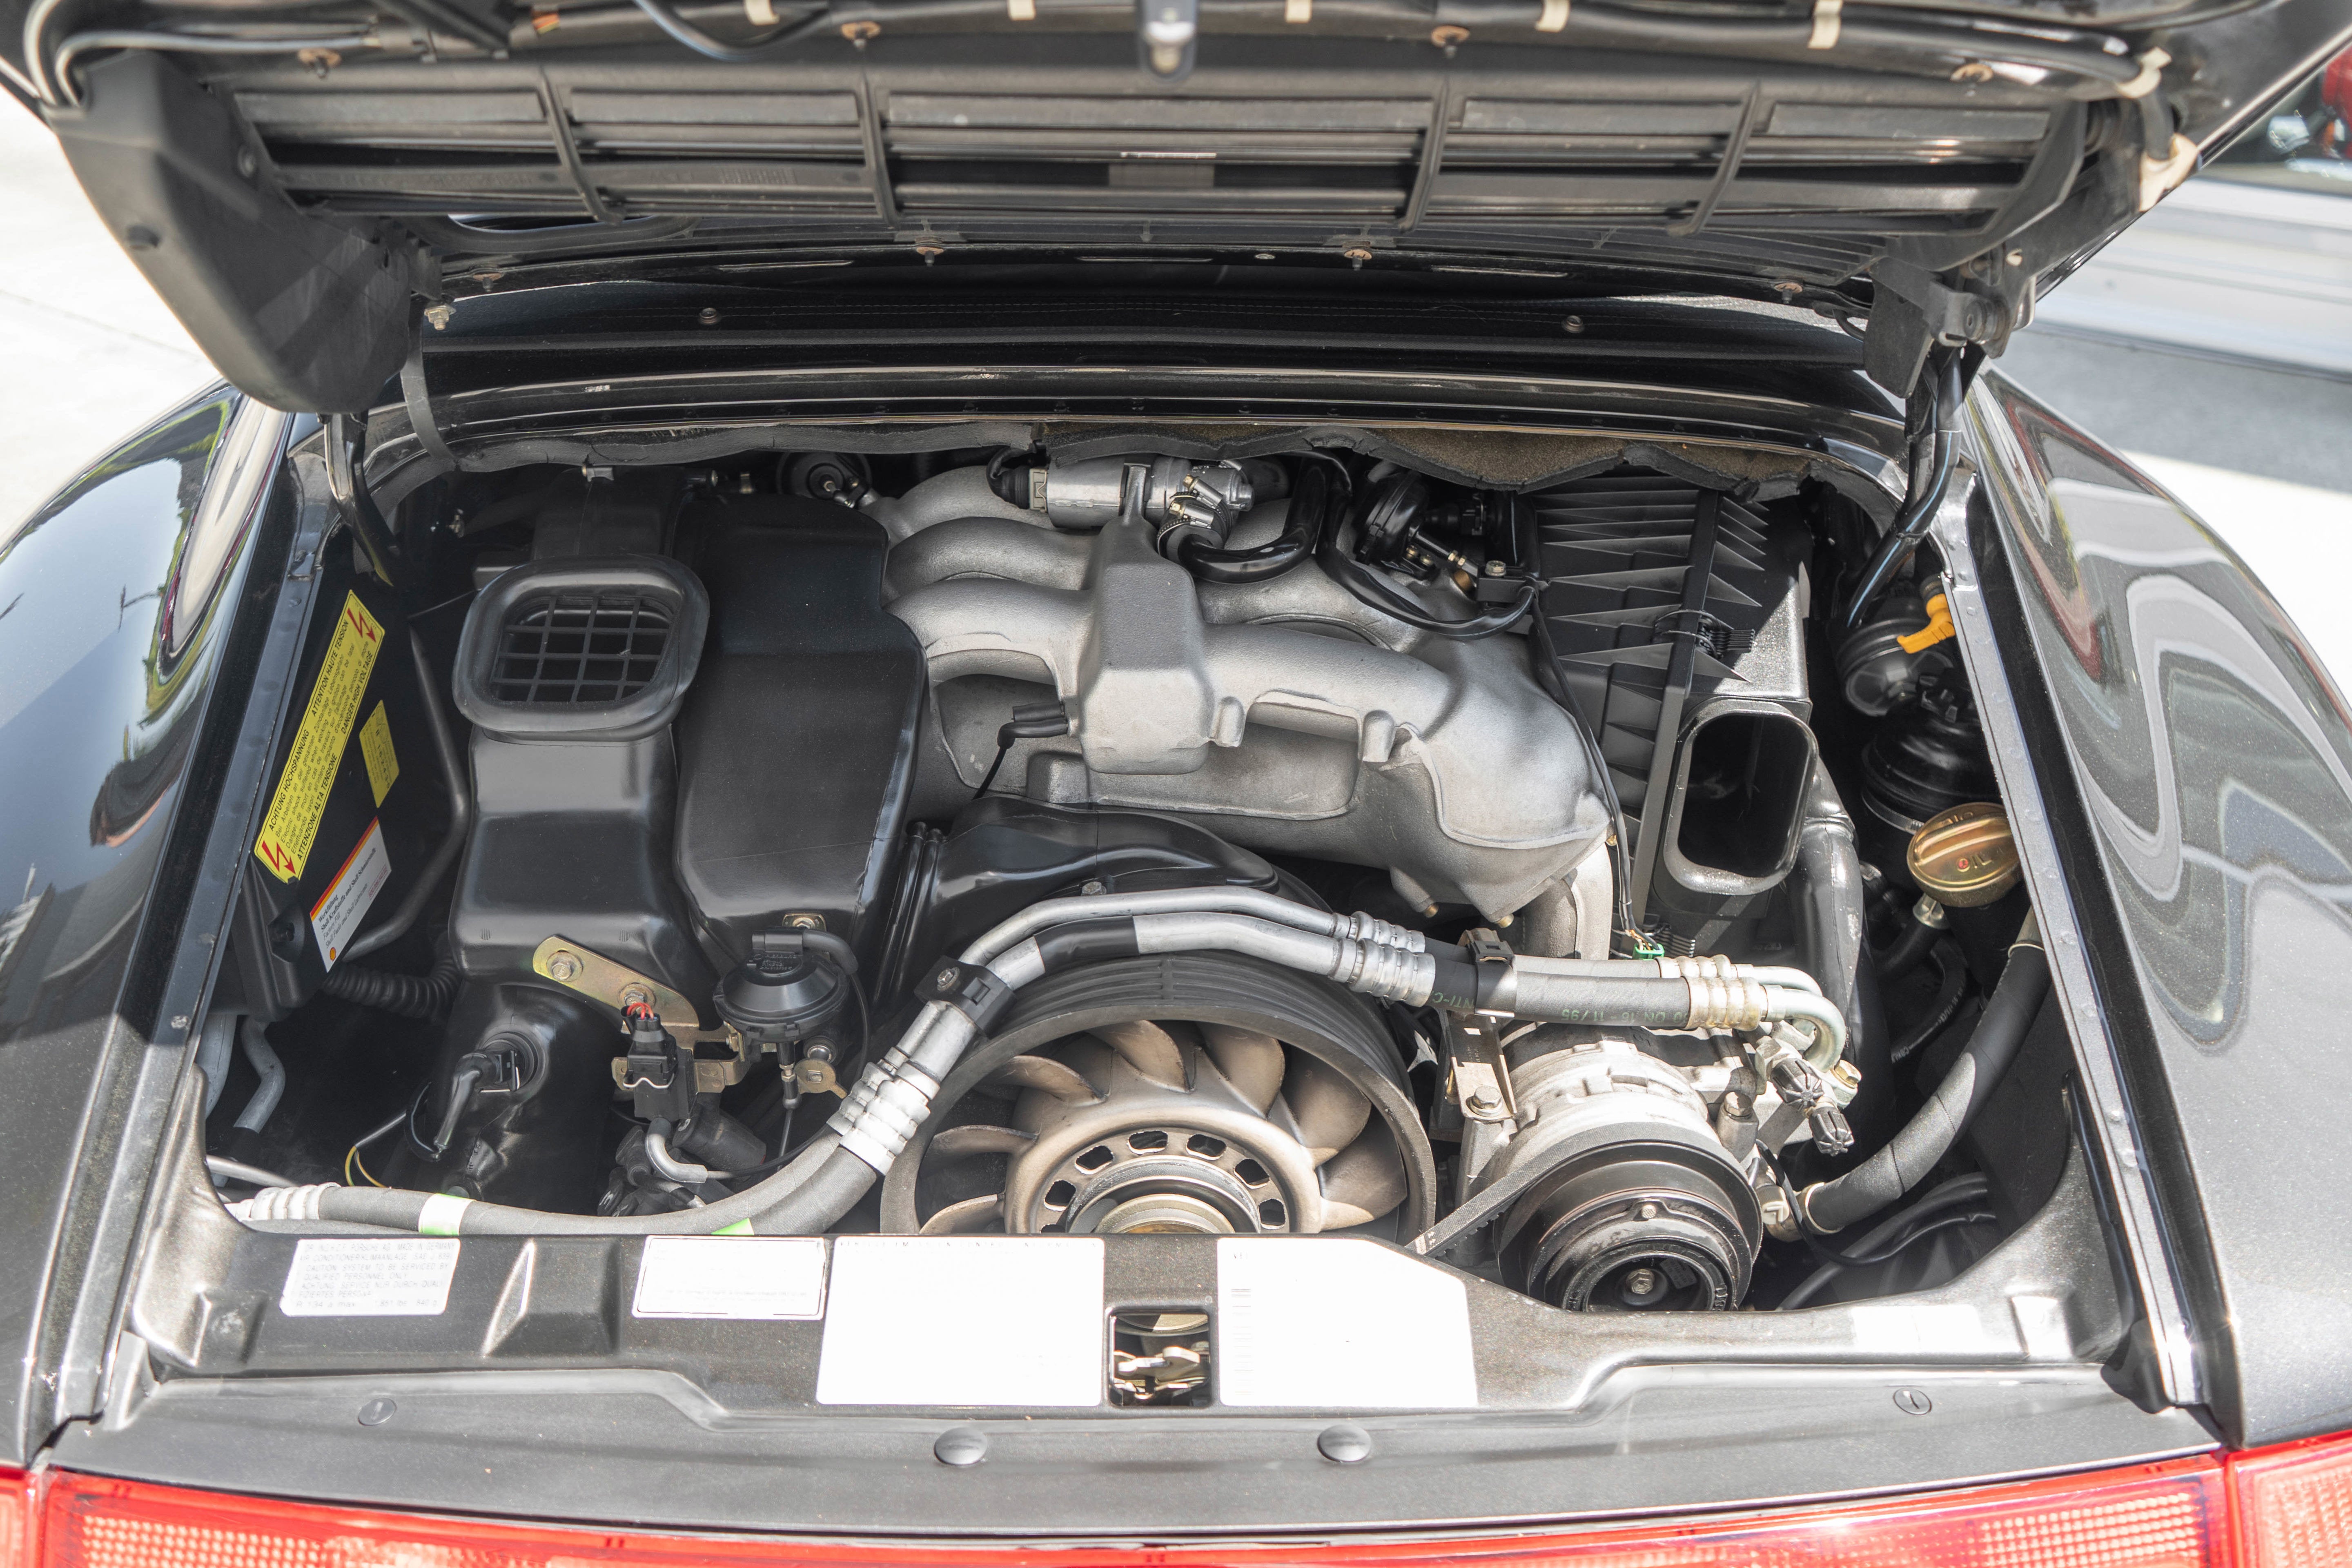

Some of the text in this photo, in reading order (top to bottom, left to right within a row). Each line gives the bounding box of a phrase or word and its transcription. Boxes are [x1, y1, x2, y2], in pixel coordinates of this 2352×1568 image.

[311, 619, 348, 717] ATTENTION HAUTE TENSION
[341, 650, 373, 734] DANGER HIGH VOLTAGE
[268, 728, 309, 831] ACHTUNG HOCHSPANNUNG
[281, 817, 293, 843] Electric
[291, 794, 301, 815] shock
[299, 765, 312, 793] suffered
[310, 745, 318, 764] when
[316, 718, 328, 744] working
[327, 707, 332, 717] on
[330, 682, 341, 706] ignition
[343, 658, 349, 668] be
[281, 793, 294, 823] Arbeiten
[292, 782, 298, 792] an
[301, 734, 316, 767] gesamten
[285, 823, 298, 849] Danger
[295, 811, 302, 822] de
[300, 793, 308, 809] mort
[307, 782, 312, 791] en
[316, 755, 322, 765] de
[320, 729, 331, 754] travaux
[291, 815, 307, 854] Effettuando
[305, 794, 315, 813] lavori
[323, 735, 336, 763] impianto
[296, 753, 337, 861] ATTENZIONE ALTA TENSIONE
[1956, 854, 1992, 873] OIL
[321, 917, 329, 933] Shell
[323, 920, 335, 942] Factory
[1432, 991, 1473, 1009] NTI-C
[1644, 1011, 1666, 1023] DN
